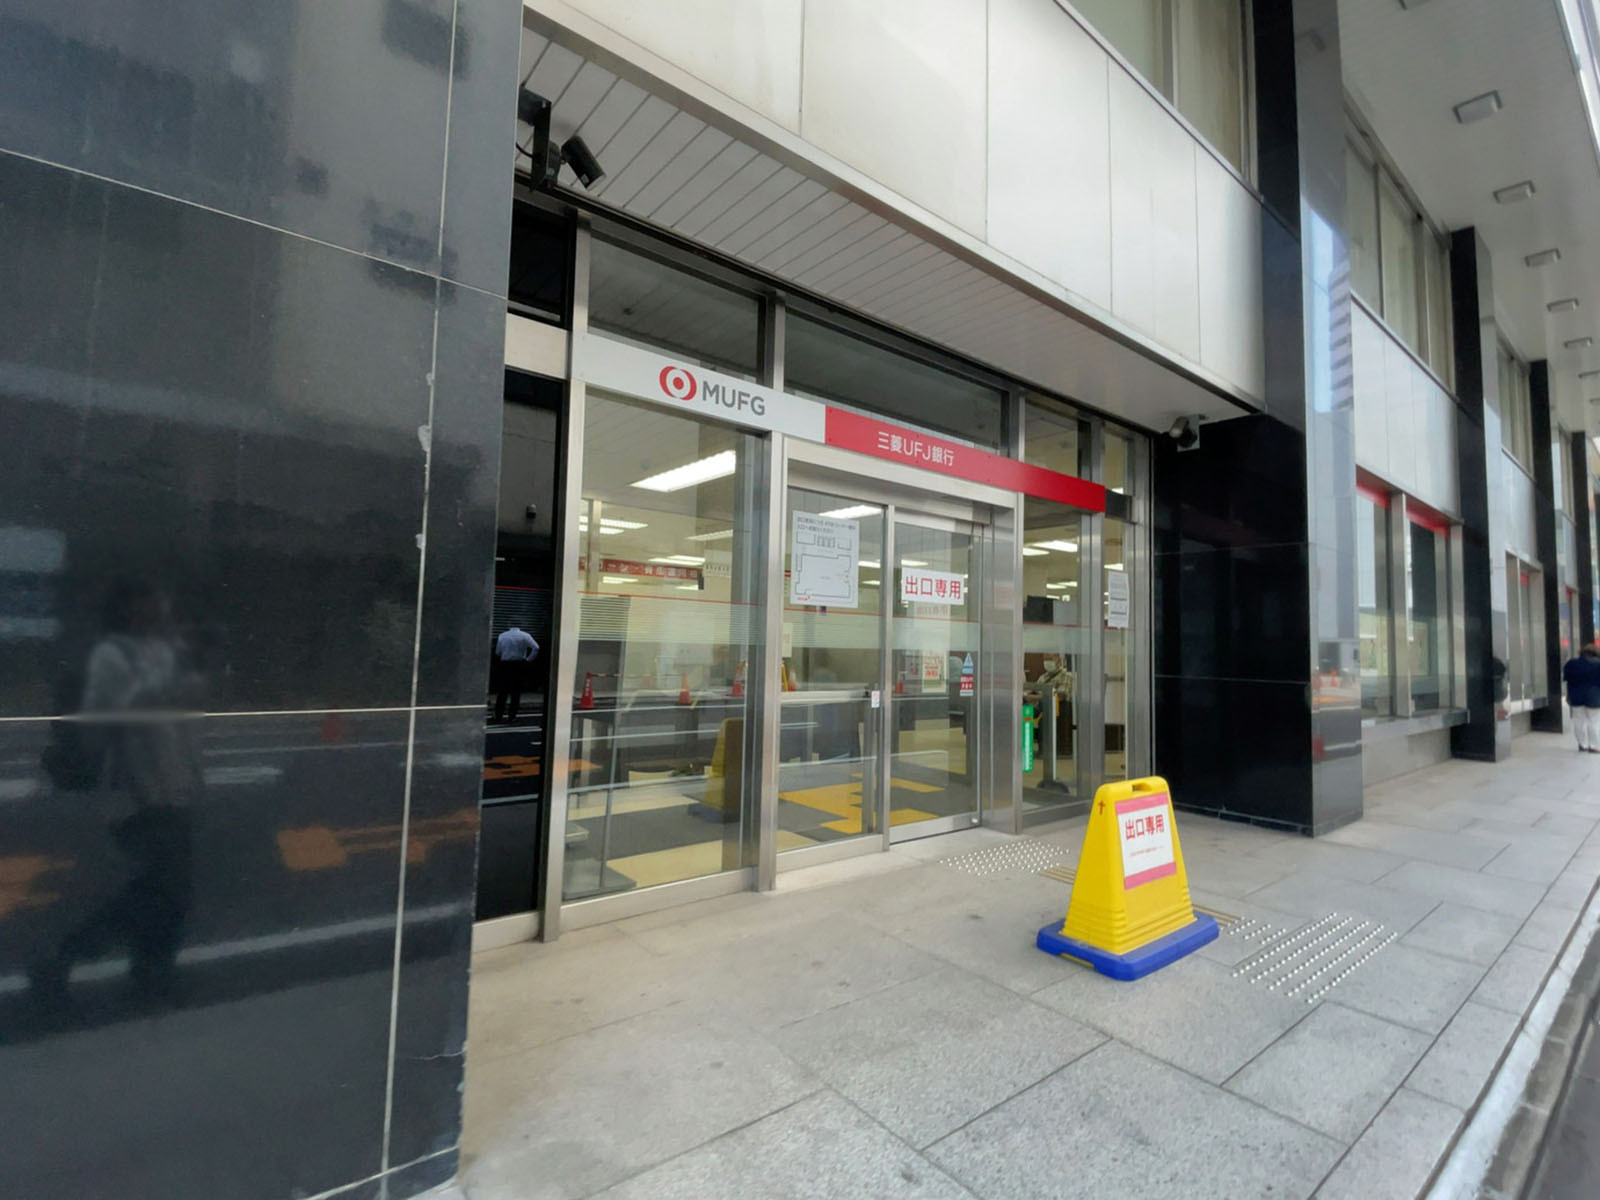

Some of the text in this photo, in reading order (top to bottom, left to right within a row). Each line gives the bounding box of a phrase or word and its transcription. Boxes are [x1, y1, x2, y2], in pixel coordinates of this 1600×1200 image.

[702, 380, 766, 416] MUFG
[877, 431, 954, 467] 三菱UFJ銀行
[904, 575, 961, 600] 出口専用
[1125, 814, 1165, 840] 出口専用
